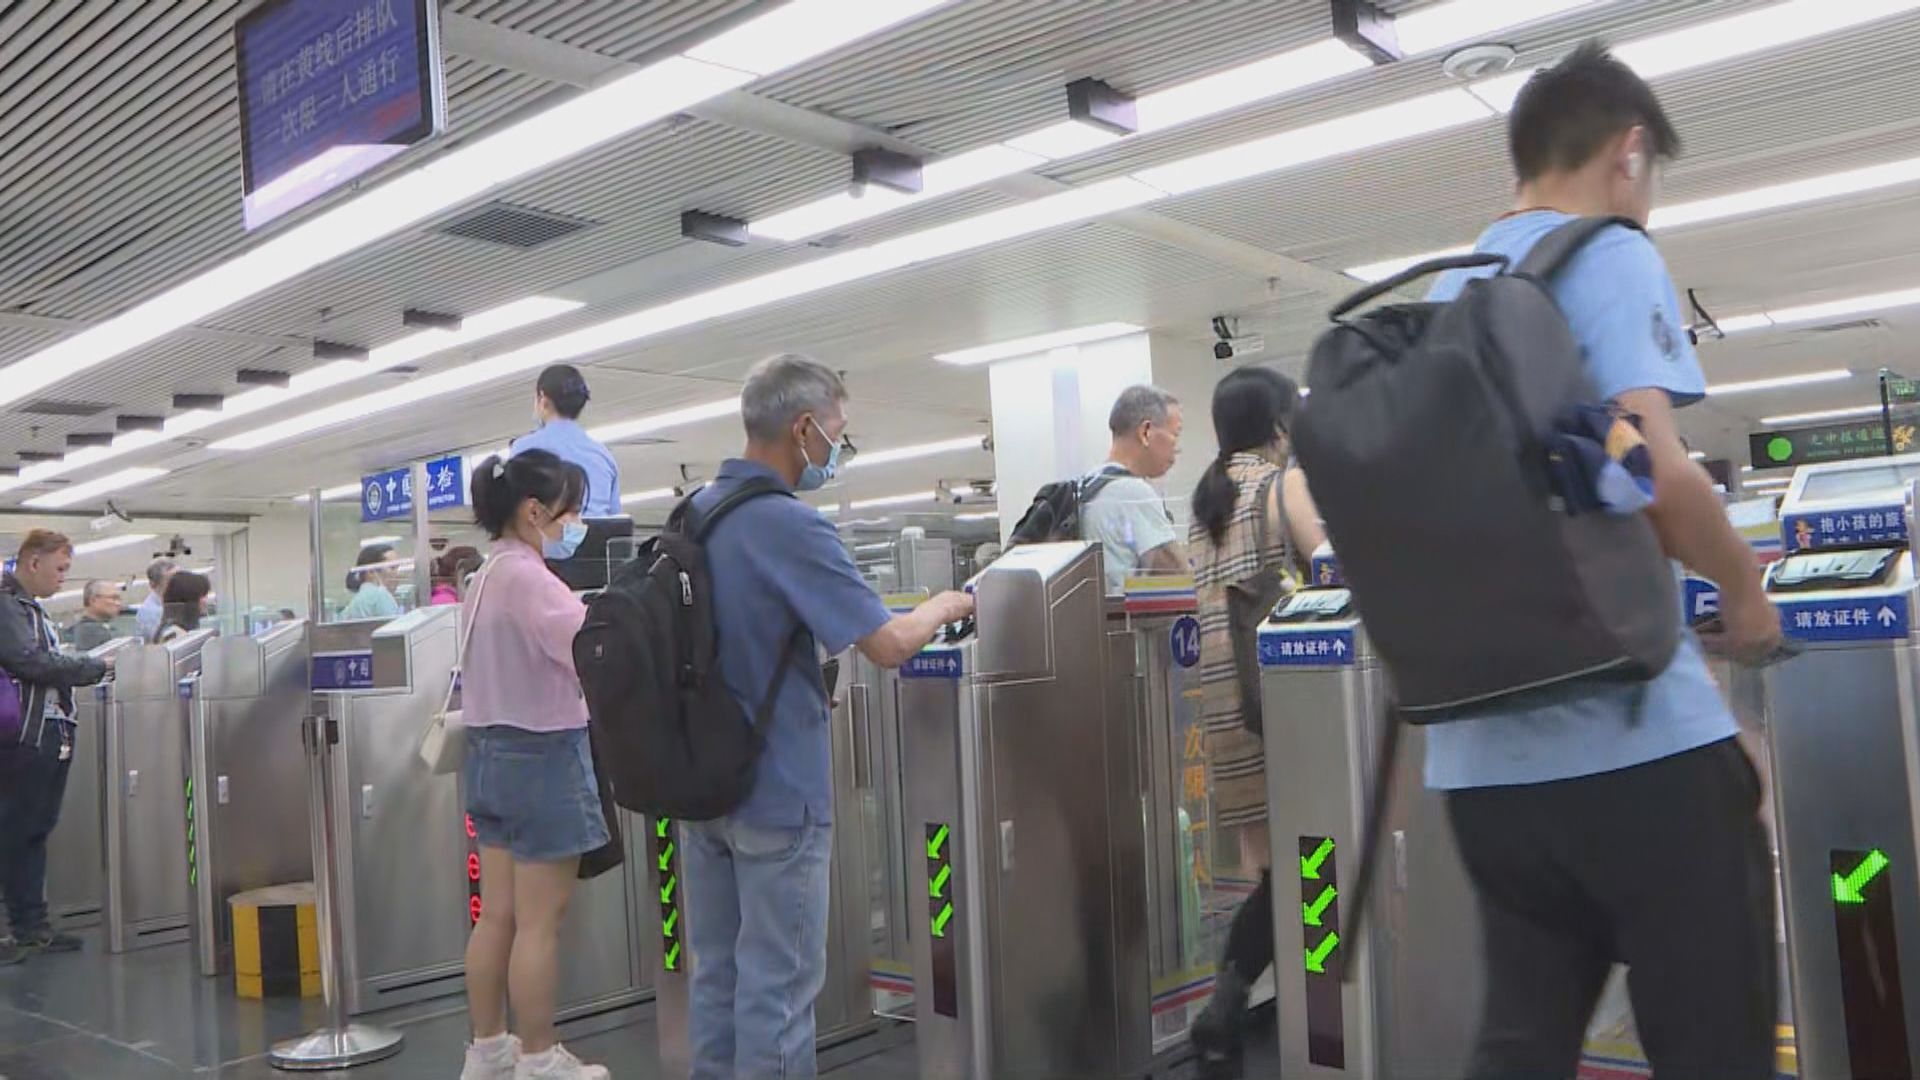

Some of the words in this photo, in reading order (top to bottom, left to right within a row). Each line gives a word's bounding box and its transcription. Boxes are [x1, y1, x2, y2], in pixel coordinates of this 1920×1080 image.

[386, 464, 455, 503] 中国检
[1821, 511, 1905, 534] 抱小孩的旅
[1795, 607, 1871, 628] 请放证件
[1175, 626, 1200, 657] 14
[1281, 640, 1330, 656] 请放证件
